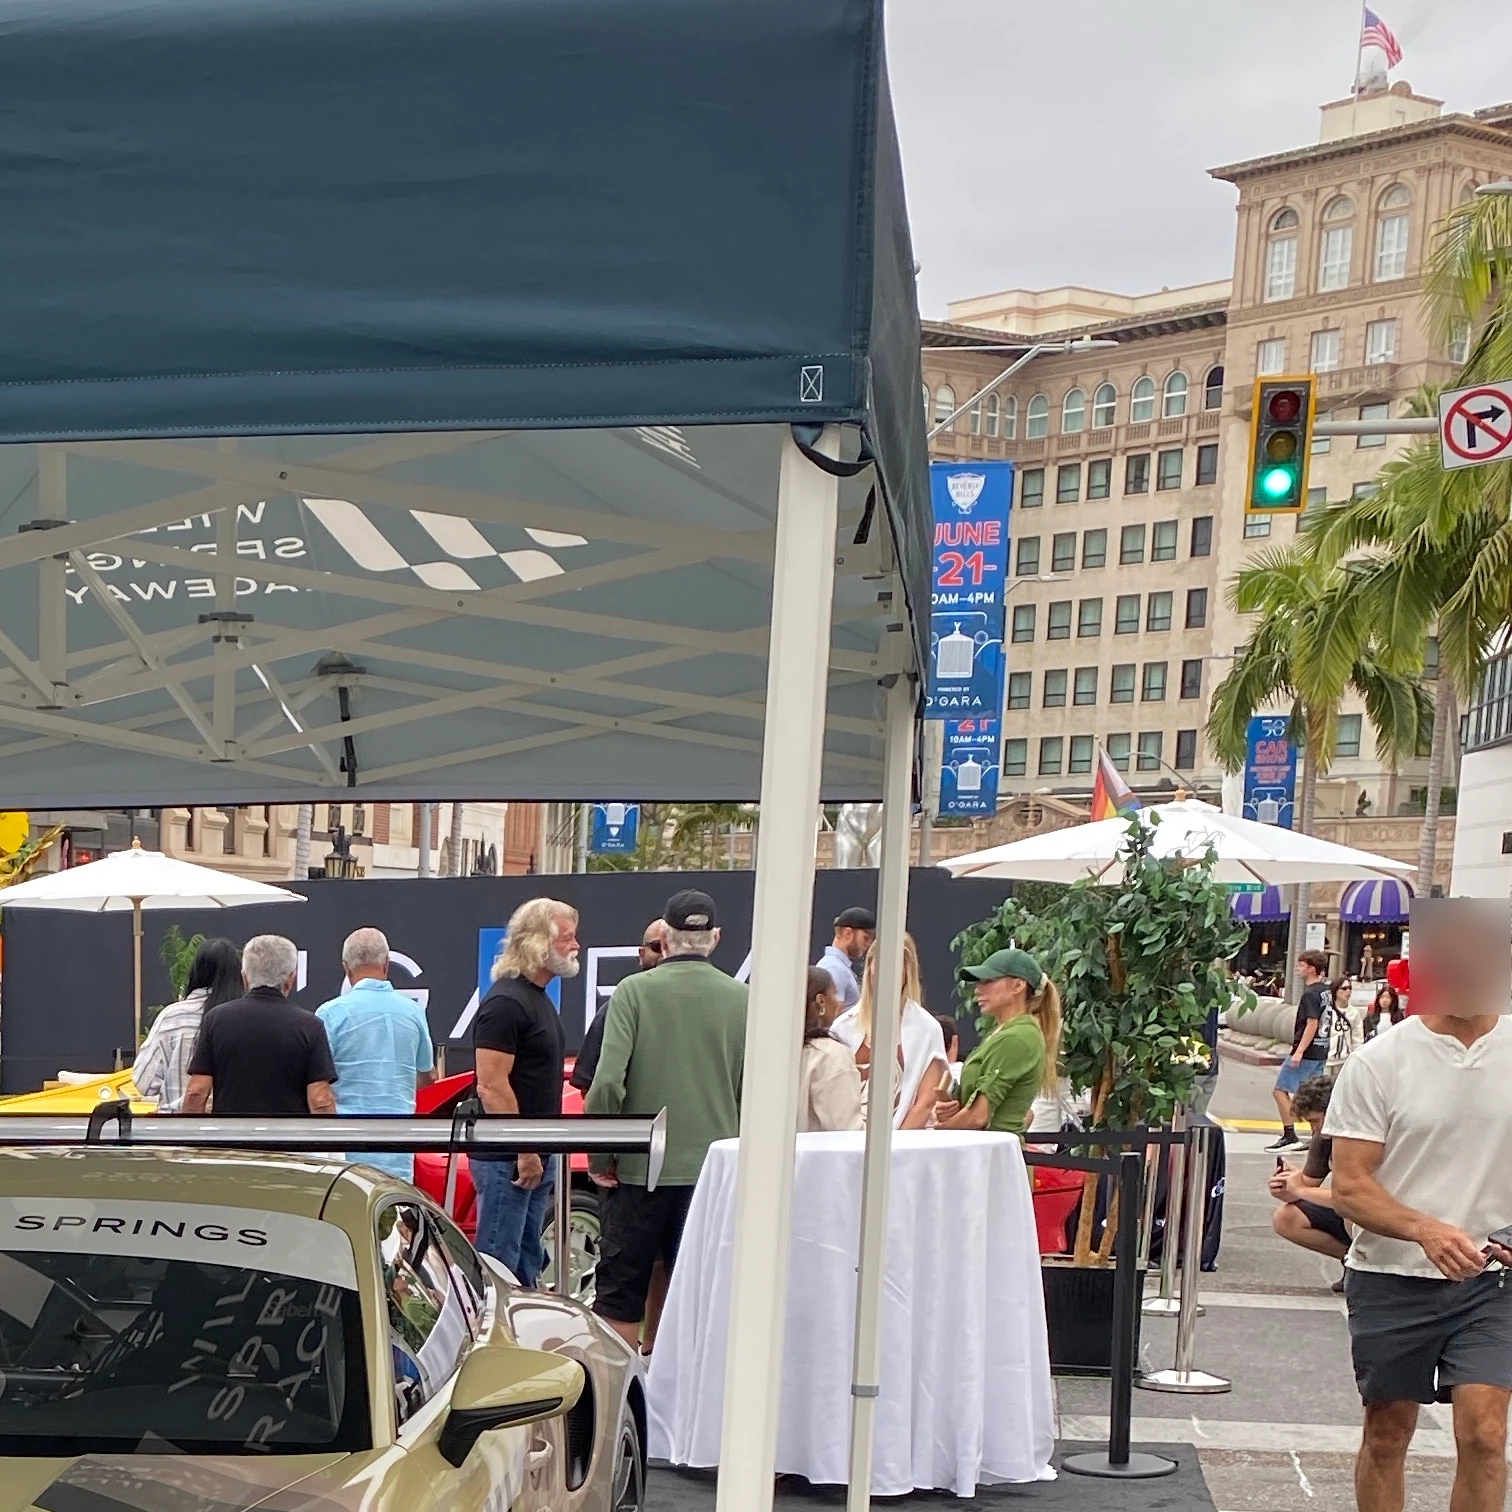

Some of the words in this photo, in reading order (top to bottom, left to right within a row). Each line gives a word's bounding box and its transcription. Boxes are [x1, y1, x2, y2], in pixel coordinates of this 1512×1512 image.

[952, 482, 980, 491] BEVERLY
[955, 490, 975, 498] HILLS
[934, 521, 1001, 547] JUNE
[938, 551, 984, 587] 21
[932, 591, 995, 605] 0AM-4PM
[14, 1214, 270, 1247] SPRINGS
